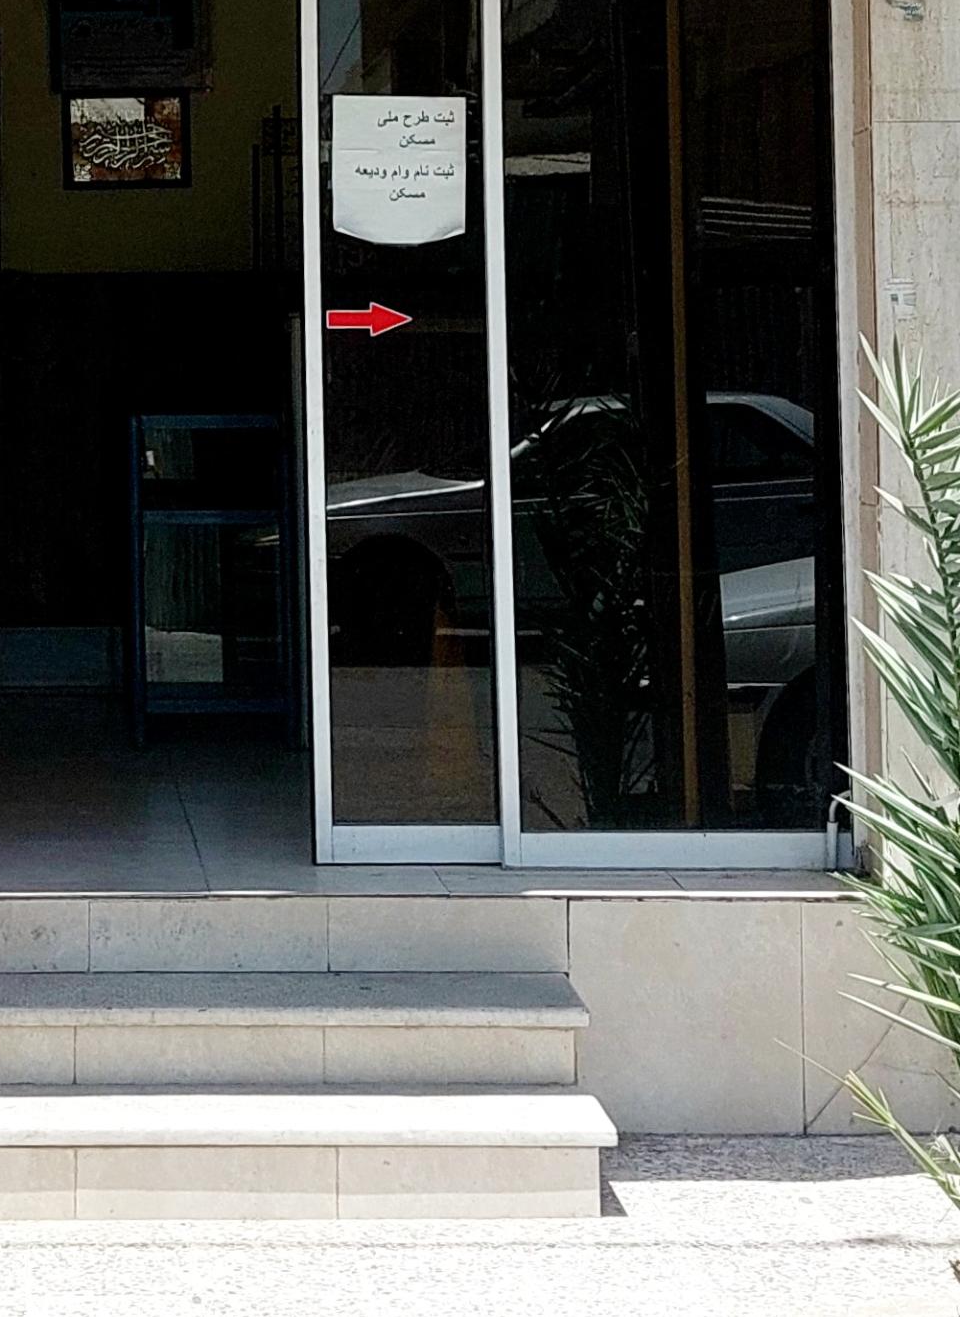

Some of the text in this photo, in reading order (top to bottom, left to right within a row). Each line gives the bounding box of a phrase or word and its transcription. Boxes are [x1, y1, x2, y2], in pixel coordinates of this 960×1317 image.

[376, 109, 456, 128] ثبت طرح ملی
[398, 133, 436, 148] مسکن
[354, 163, 456, 181] ثبت نام وام ودیعه
[388, 187, 427, 201] مسکن
